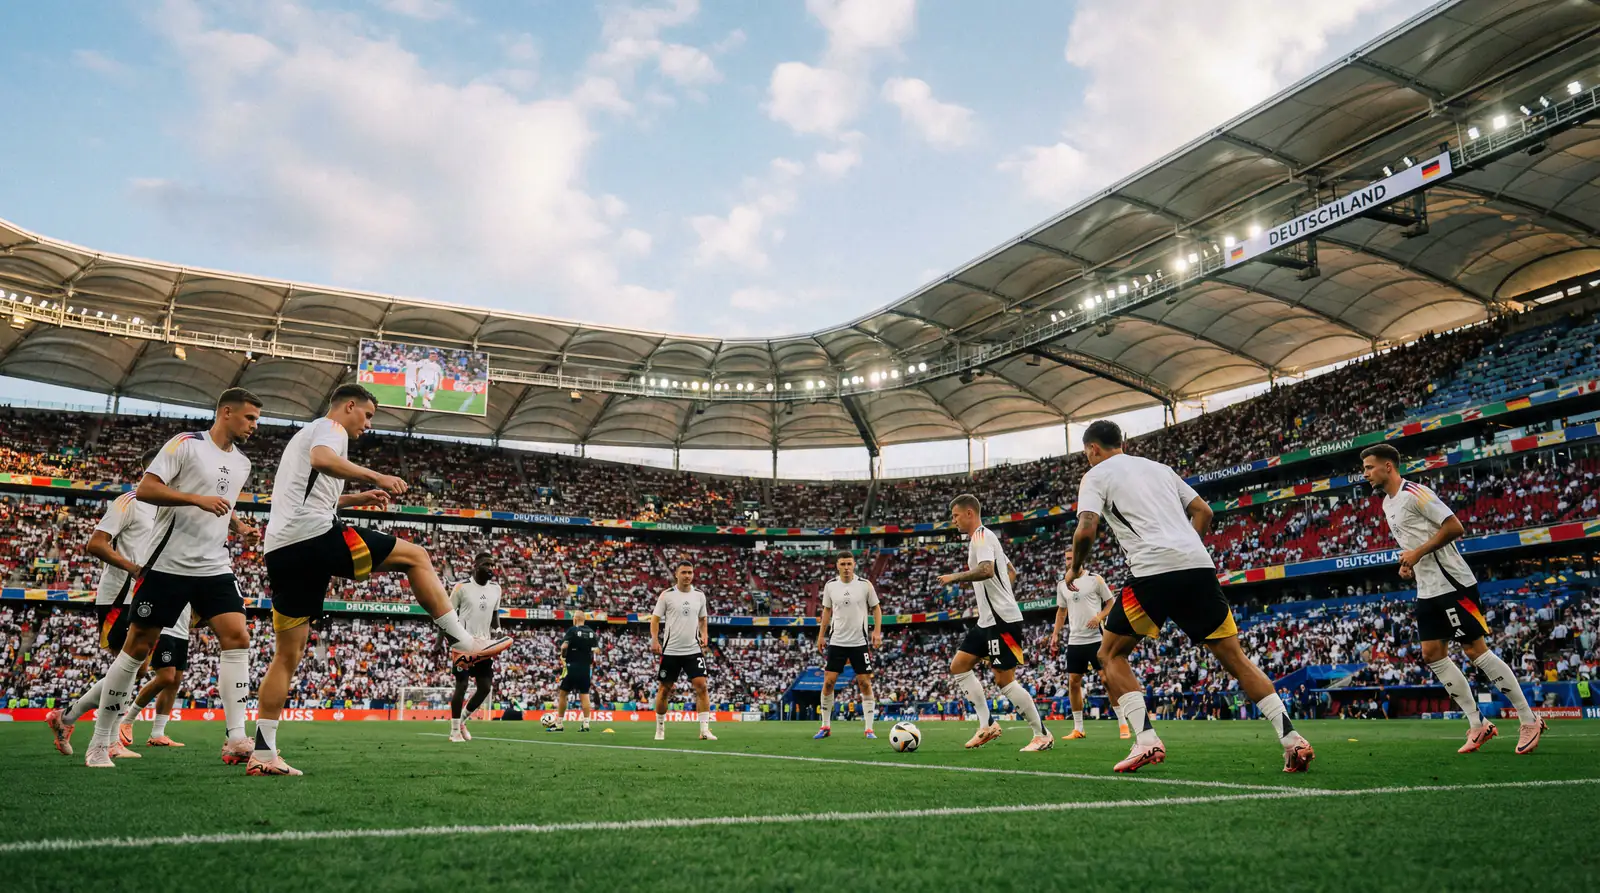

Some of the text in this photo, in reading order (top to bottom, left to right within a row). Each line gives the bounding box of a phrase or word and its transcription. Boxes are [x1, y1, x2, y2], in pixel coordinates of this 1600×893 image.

[1269, 184, 1387, 246] DEUTSCHLAND
[1310, 438, 1354, 456] GERMANY
[1199, 463, 1253, 482] DEUTSCHLAND
[1336, 550, 1401, 568] DEUTSCHLA
[346, 602, 411, 613] DEUTSCHLAND
[1445, 607, 1461, 628] 6
[988, 638, 1001, 656] 18
[863, 652, 871, 665] 8
